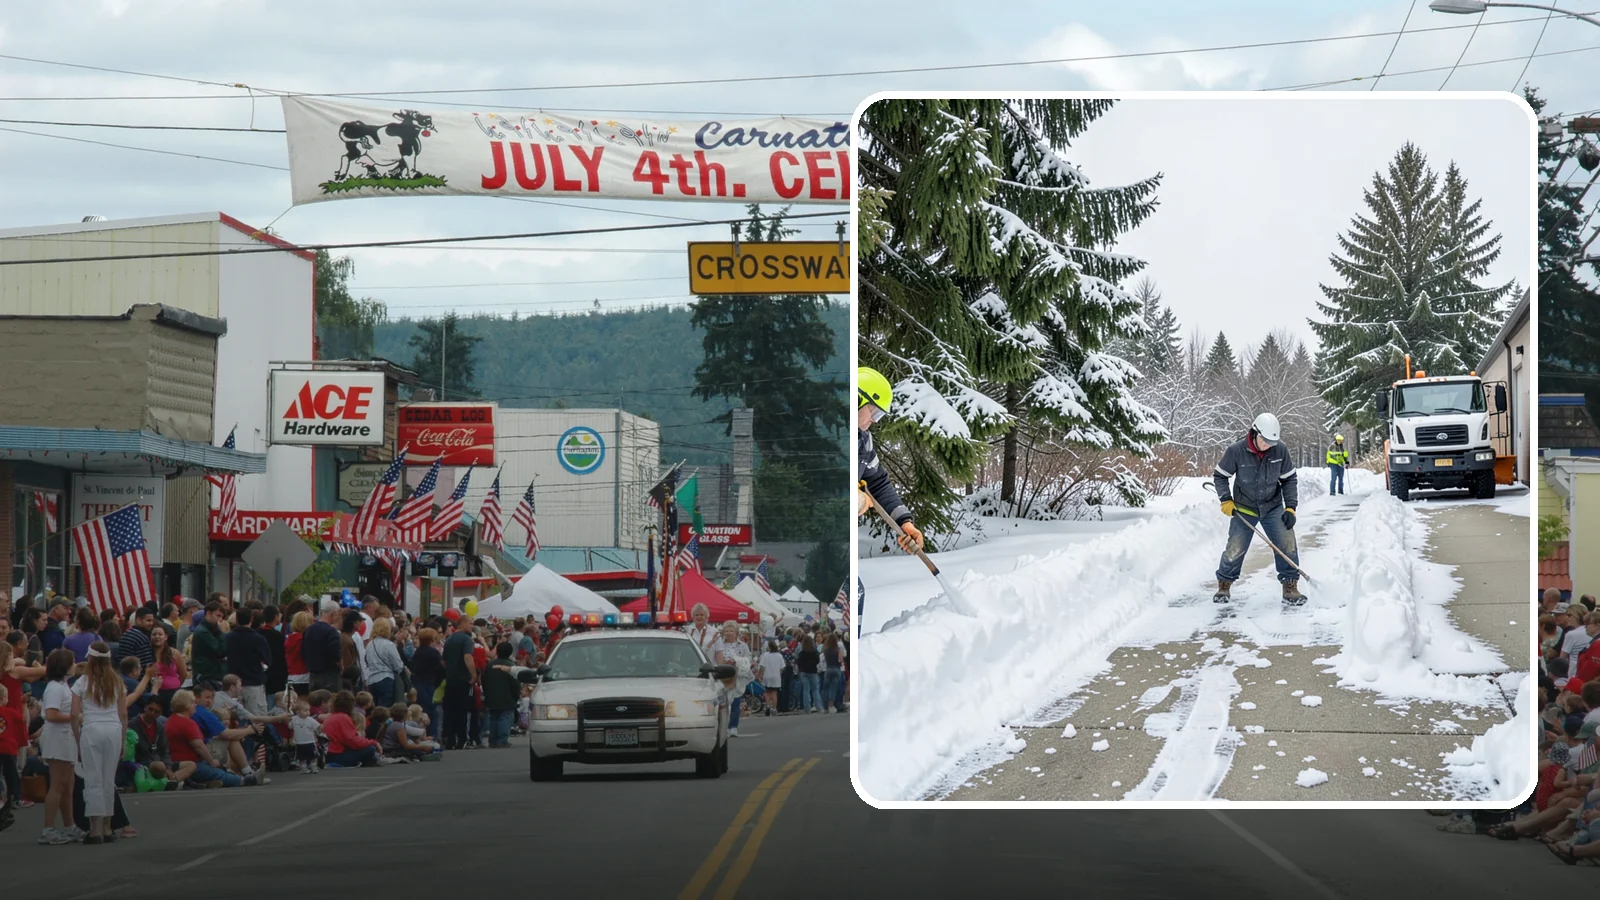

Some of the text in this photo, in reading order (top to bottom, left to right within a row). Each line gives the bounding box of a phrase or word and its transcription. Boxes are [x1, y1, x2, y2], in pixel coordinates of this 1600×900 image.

[695, 121, 850, 149] Carnat
[481, 140, 605, 192] JULY
[632, 150, 746, 198] 4th.
[697, 254, 850, 280] CROSSWA
[283, 380, 373, 419] ACE
[405, 409, 452, 422] CEDAR
[284, 421, 371, 436] Hardware
[416, 428, 477, 447] Coca-Cola
[353, 467, 385, 481] Simpl
[96, 484, 124, 495] Vincent
[126, 486, 136, 495] de
[137, 486, 155, 496] Paul
[81, 503, 154, 522] THT
[212, 515, 331, 536] HARDARE
[688, 526, 741, 535] CRNATION
[699, 535, 730, 543] GLASS
